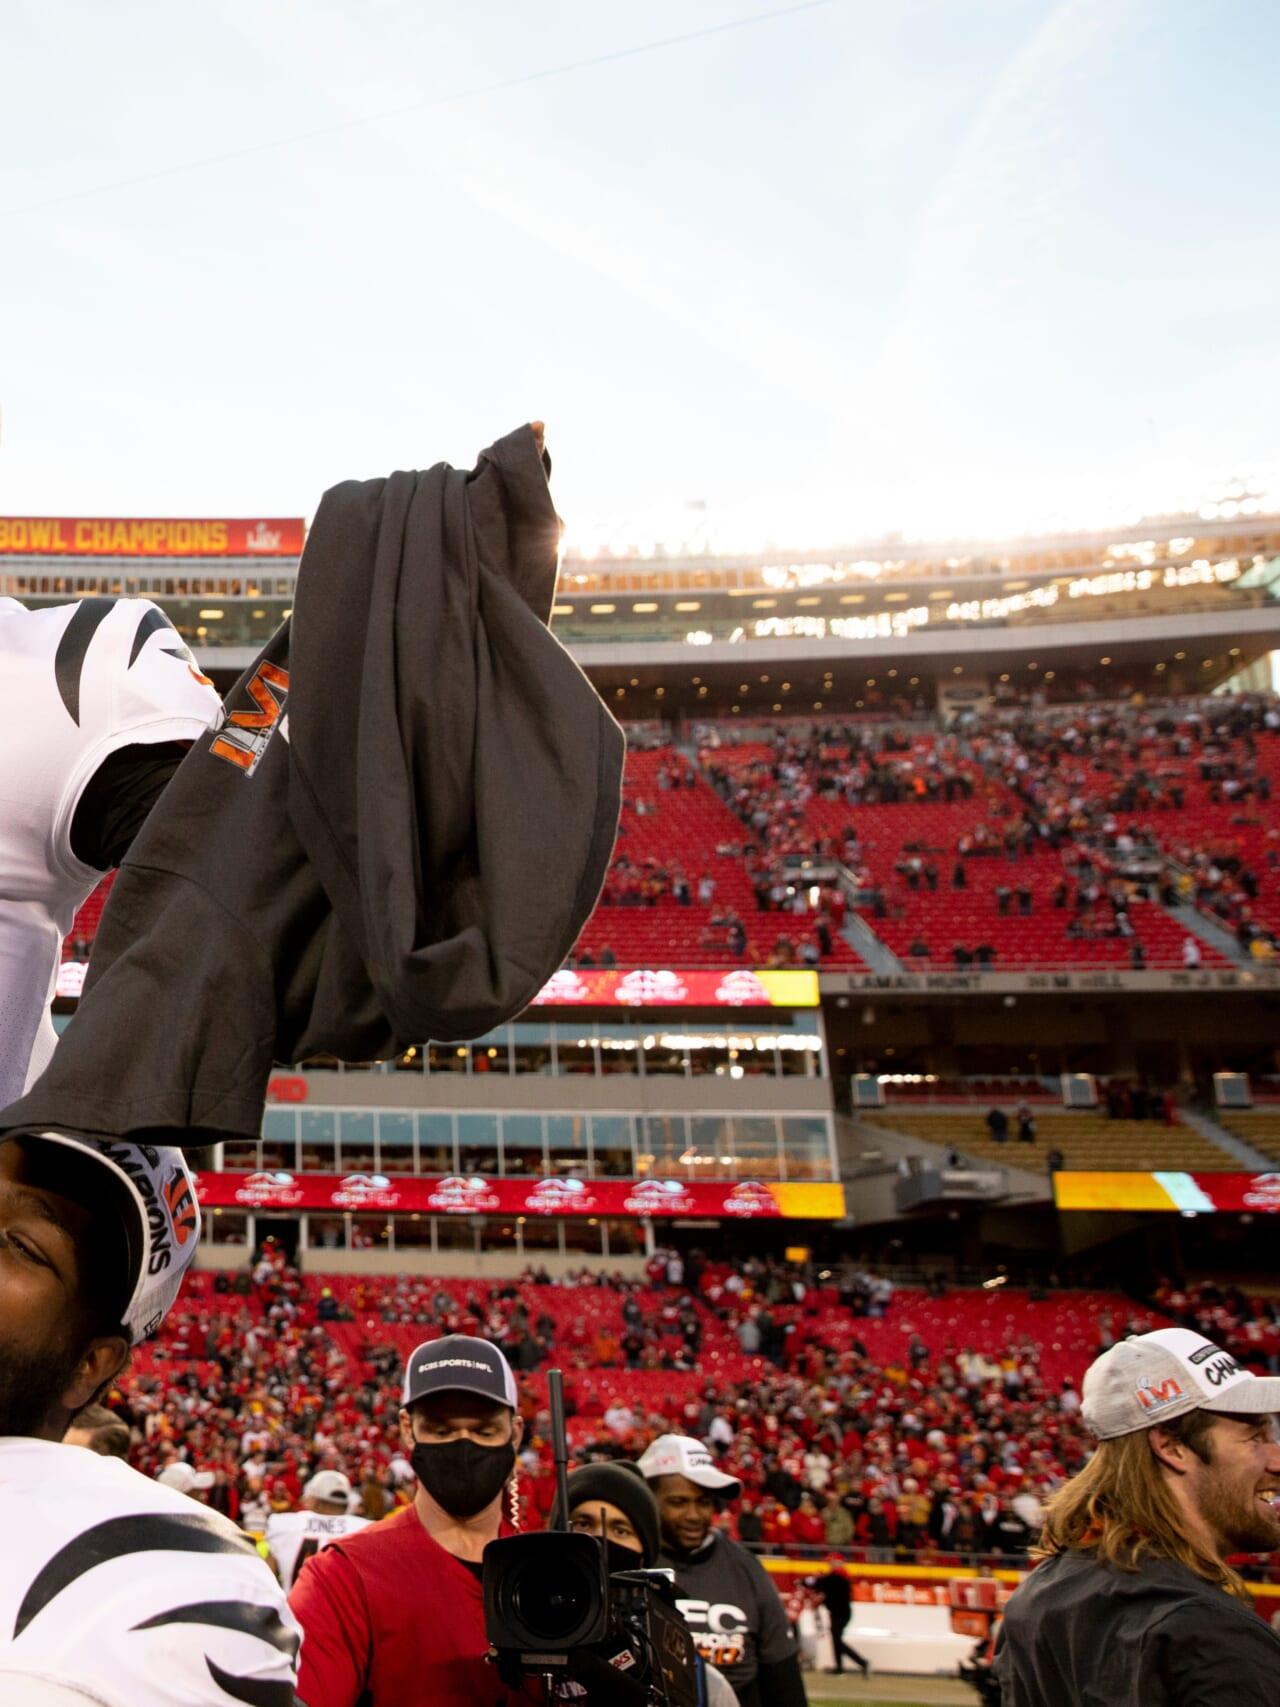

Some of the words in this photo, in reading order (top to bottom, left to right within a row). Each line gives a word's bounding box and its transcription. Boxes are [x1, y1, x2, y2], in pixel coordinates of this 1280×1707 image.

[74, 521, 228, 550] CHAMPIONS
[439, 1359, 472, 1368] SPORTS
[476, 1361, 493, 1373] NFL
[304, 1517, 345, 1533] JONES
[674, 1599, 749, 1634] FC
